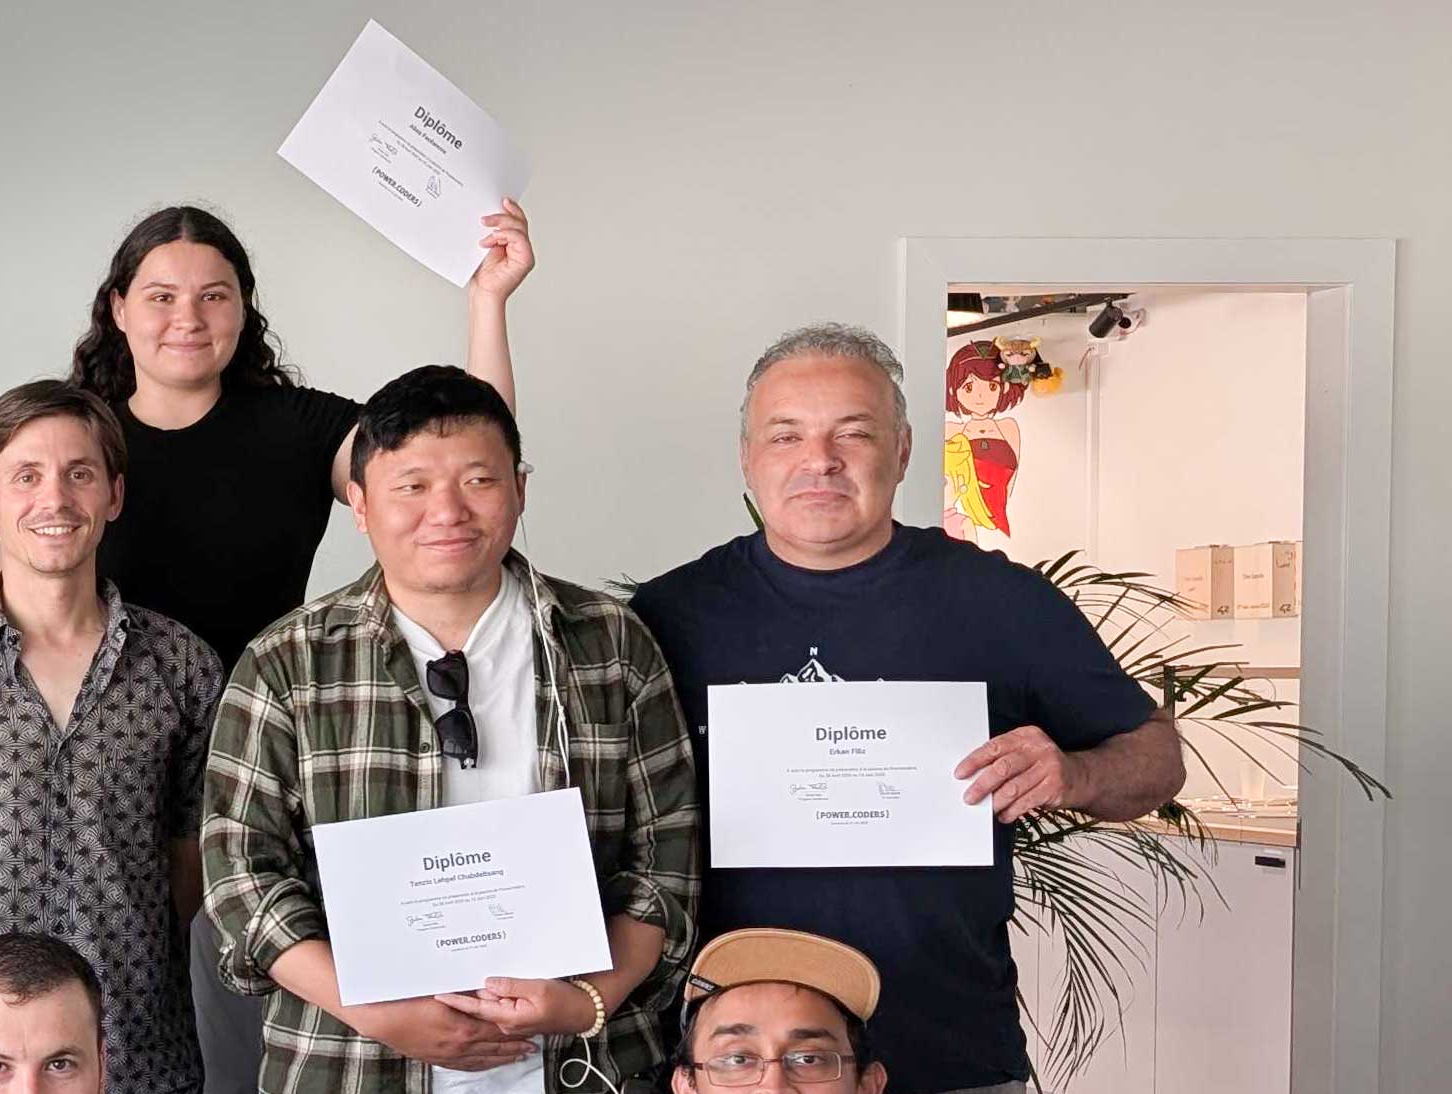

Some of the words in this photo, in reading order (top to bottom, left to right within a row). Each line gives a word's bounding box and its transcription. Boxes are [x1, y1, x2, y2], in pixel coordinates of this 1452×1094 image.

[414, 106, 462, 149] Diplôme
[809, 646, 818, 656] N
[816, 726, 887, 744] Diplôme
[423, 851, 491, 872] Diplôme
